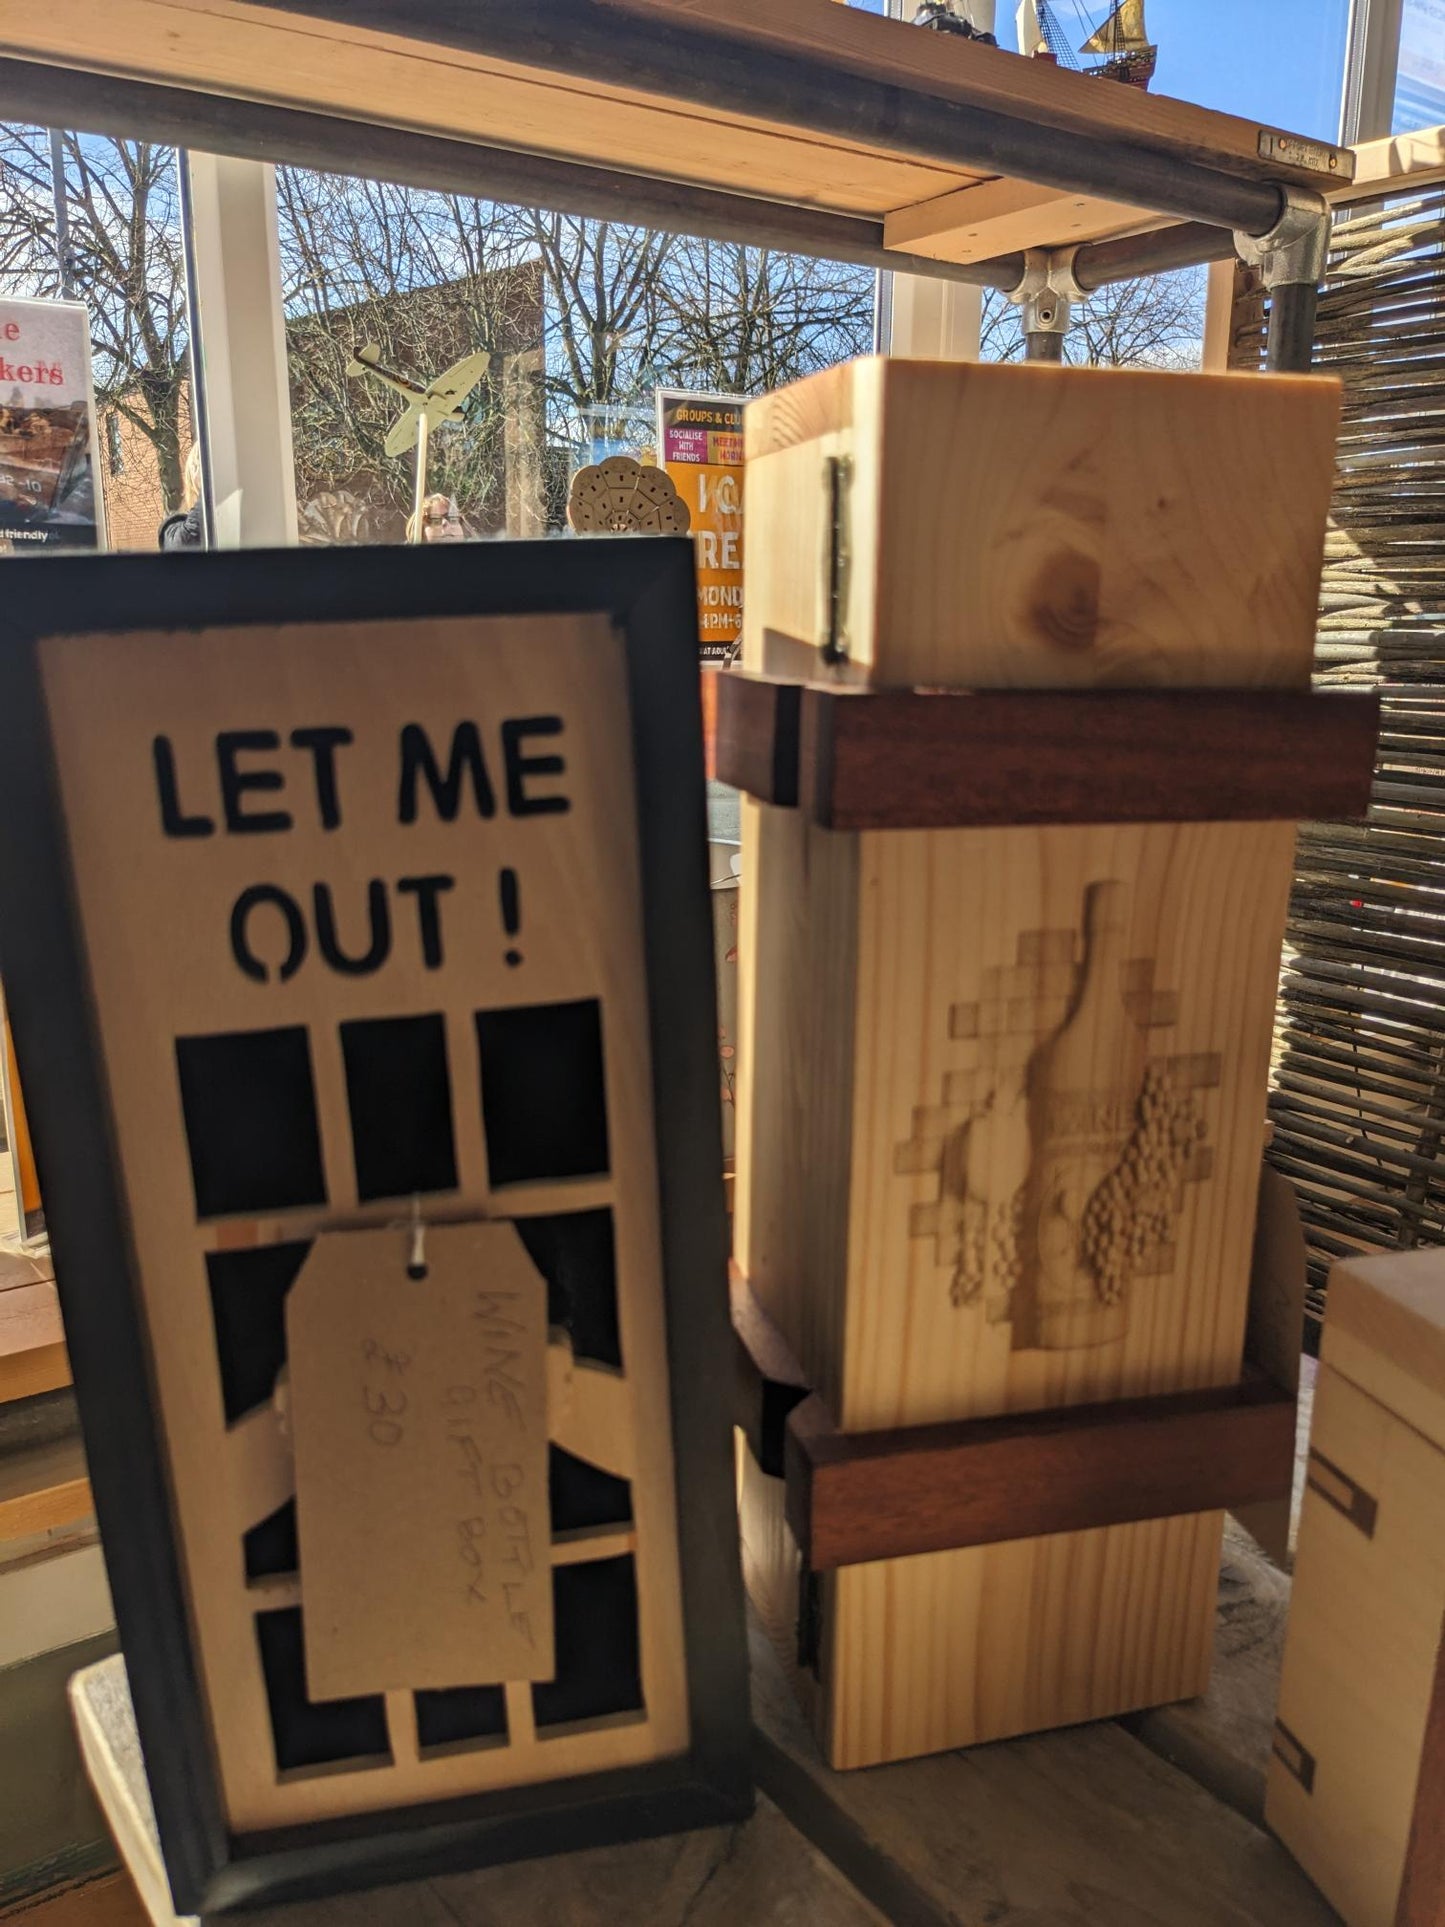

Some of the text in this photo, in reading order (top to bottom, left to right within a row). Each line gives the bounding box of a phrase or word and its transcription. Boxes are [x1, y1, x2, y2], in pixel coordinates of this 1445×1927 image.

[676, 409, 713, 423] GROUPS
[715, 412, 722, 424] &
[669, 429, 703, 441] SOCIALISE
[678, 440, 694, 451] WITH
[672, 452, 701, 462] FRIENDS
[5, 529, 48, 543] friendly
[152, 715, 571, 840] LET ME
[229, 873, 456, 985] OUT
[472, 1290, 537, 1652] WINE BOTTLE
[456, 1516, 489, 1606] BOX
